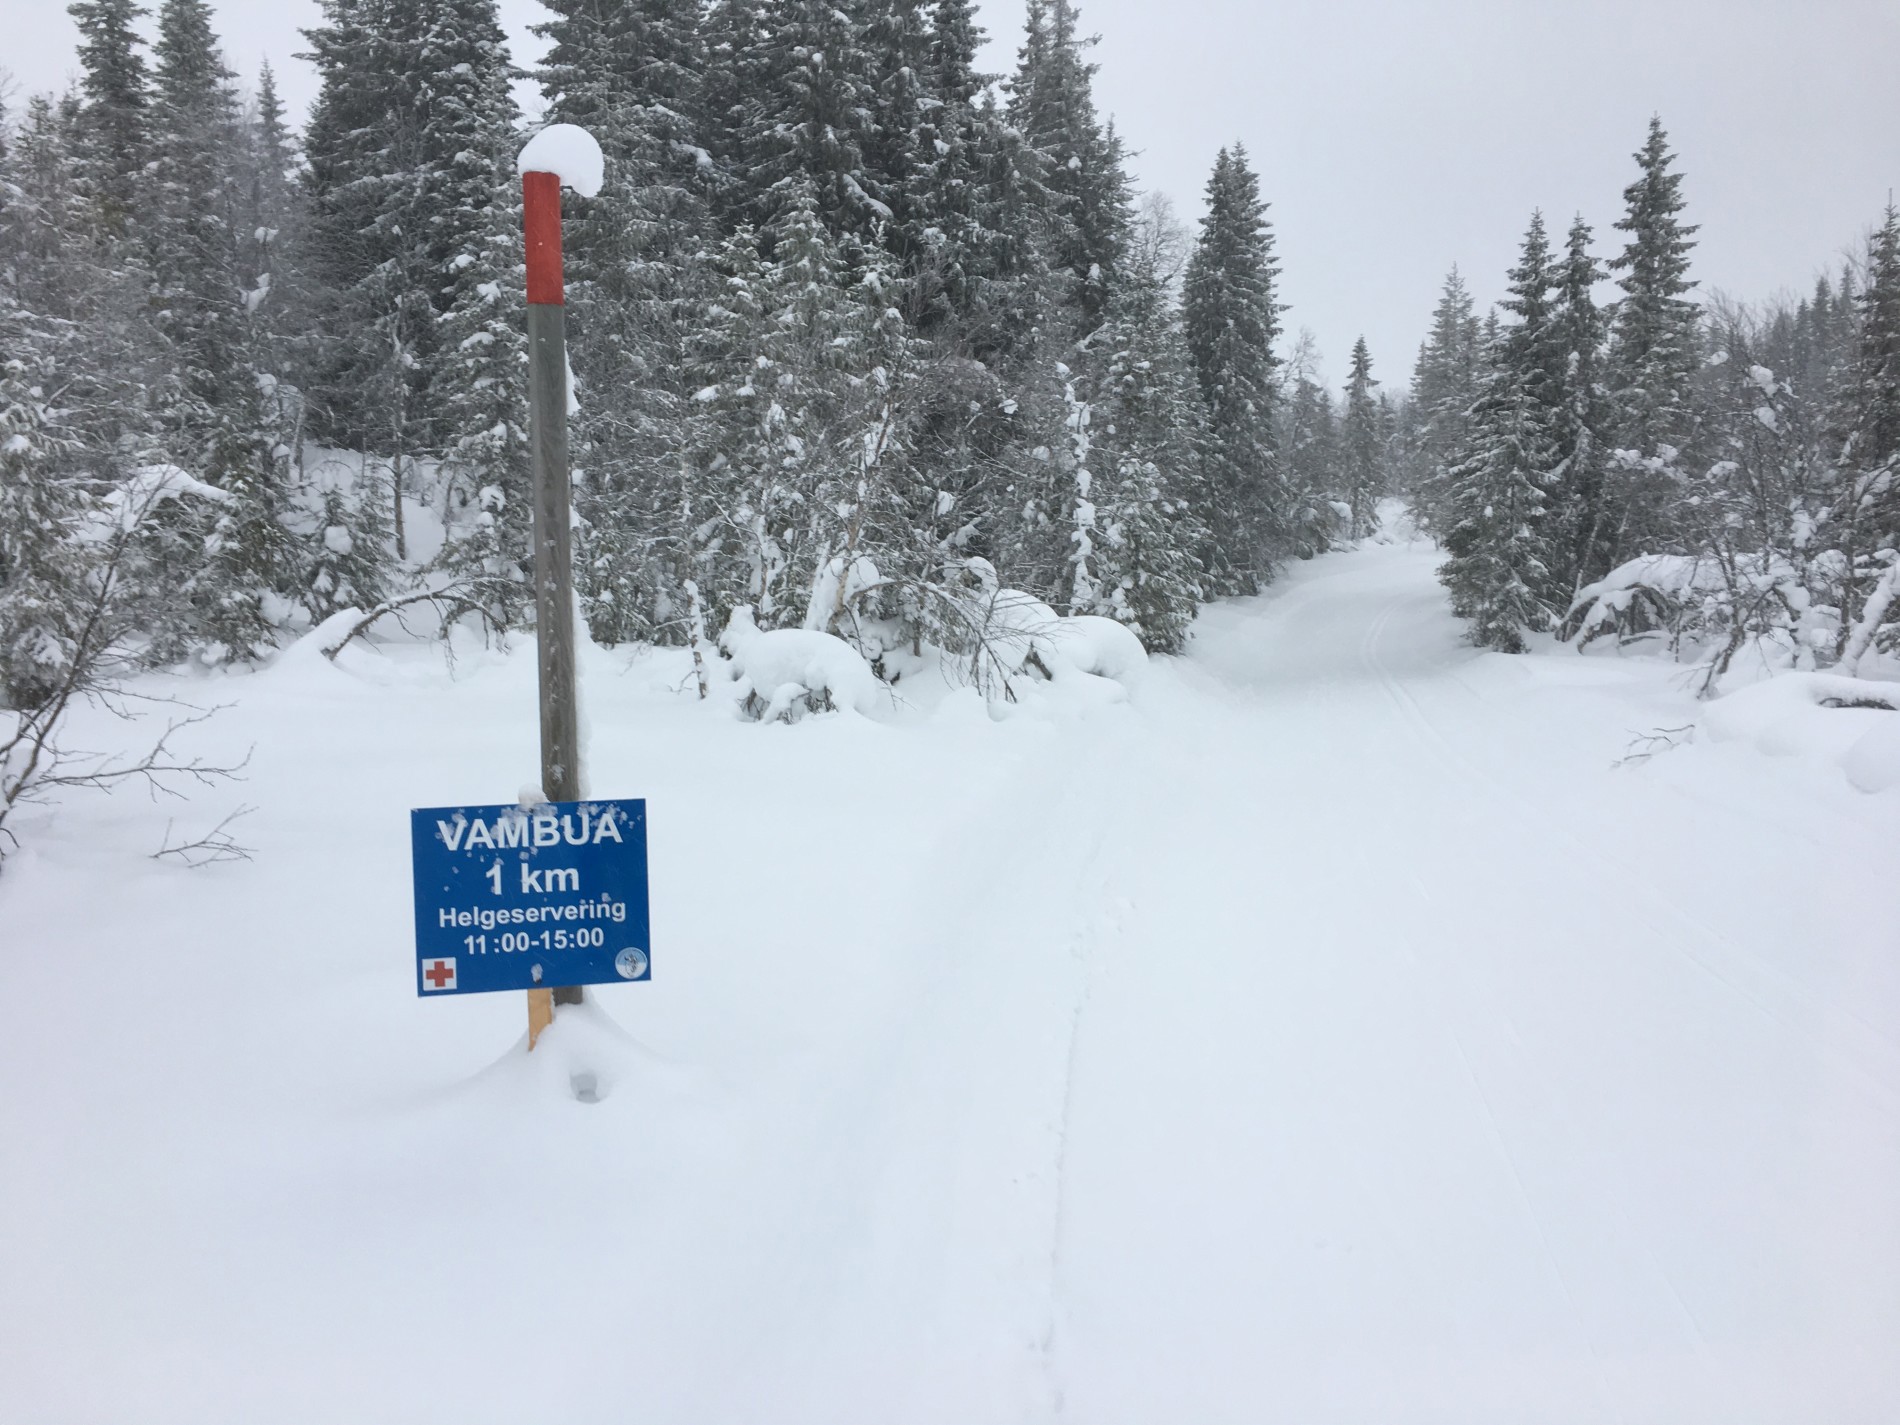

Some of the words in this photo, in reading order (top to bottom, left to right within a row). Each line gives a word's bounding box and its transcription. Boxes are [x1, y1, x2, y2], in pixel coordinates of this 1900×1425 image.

[437, 812, 623, 851] VAMBUA
[485, 864, 502, 895] 1
[521, 863, 580, 894] km
[439, 899, 626, 930] Helgeservering
